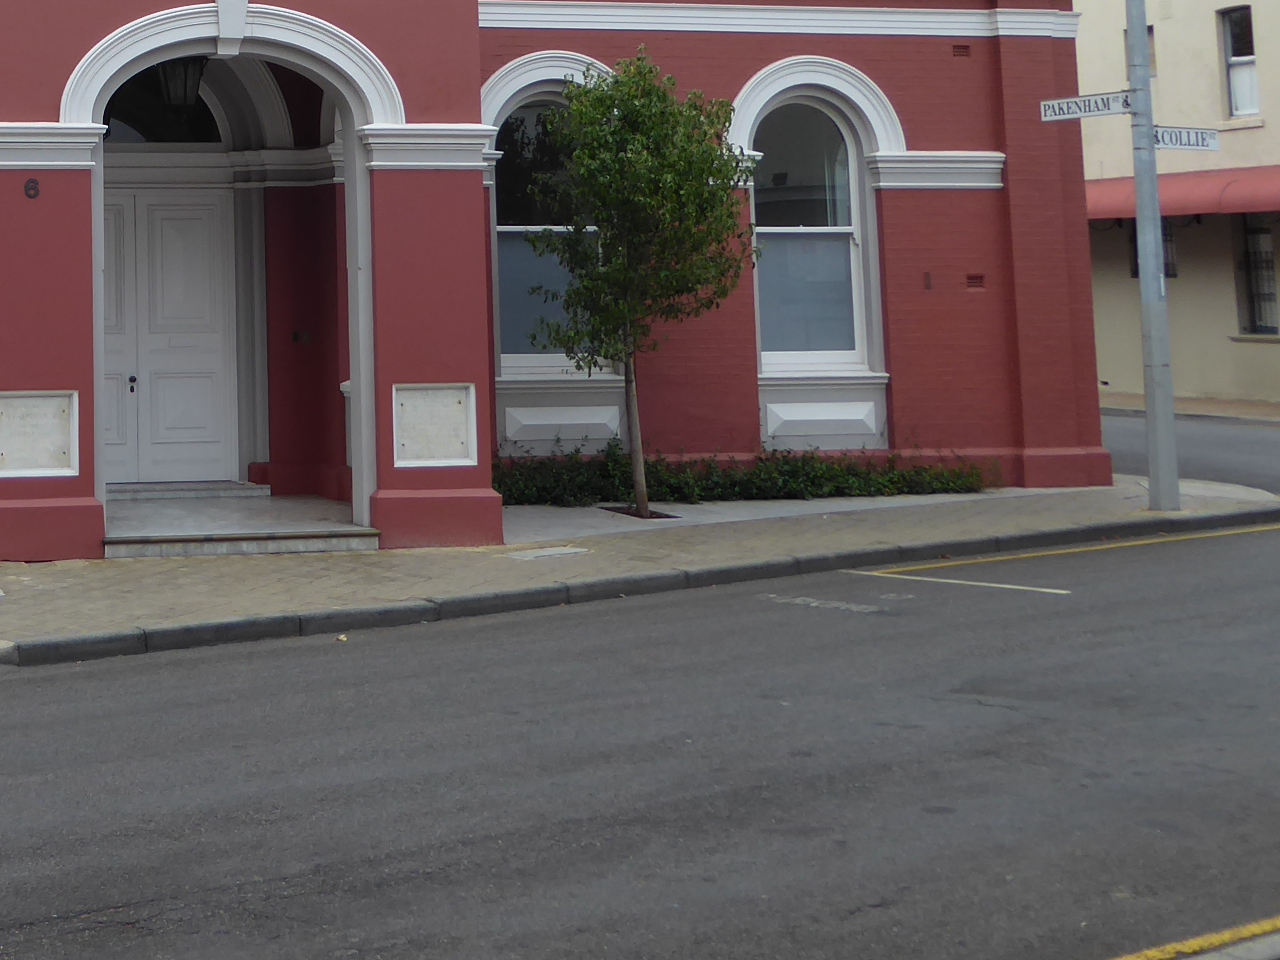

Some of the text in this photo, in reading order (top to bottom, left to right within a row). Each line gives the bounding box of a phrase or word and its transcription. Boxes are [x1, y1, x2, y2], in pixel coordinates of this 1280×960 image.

[1042, 96, 1111, 118] PAKENHAM
[1161, 129, 1209, 148] COLLIE
[24, 178, 40, 199] 6
